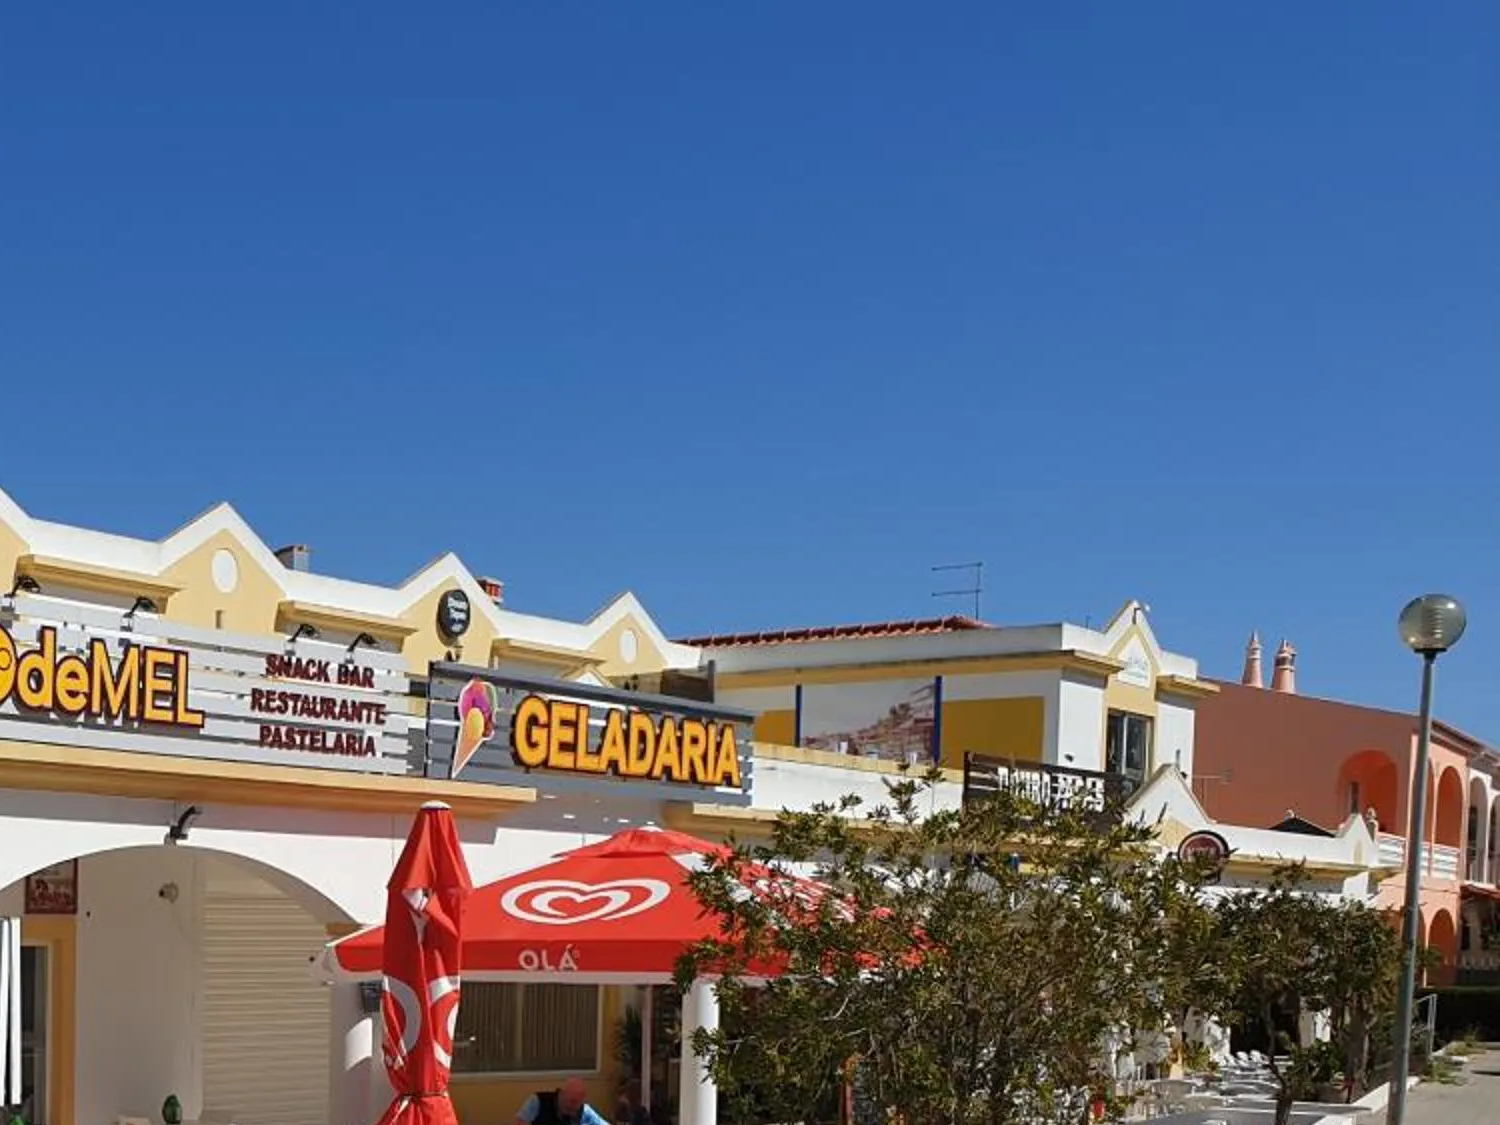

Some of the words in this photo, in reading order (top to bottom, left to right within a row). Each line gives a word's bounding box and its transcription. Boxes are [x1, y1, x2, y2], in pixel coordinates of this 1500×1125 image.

[265, 653, 331, 683] SNACK
[337, 663, 375, 688] BAR
[250, 688, 387, 725] RESTAURANTE
[260, 725, 376, 757] PASTELARIA
[513, 693, 743, 788] GELADARIA
